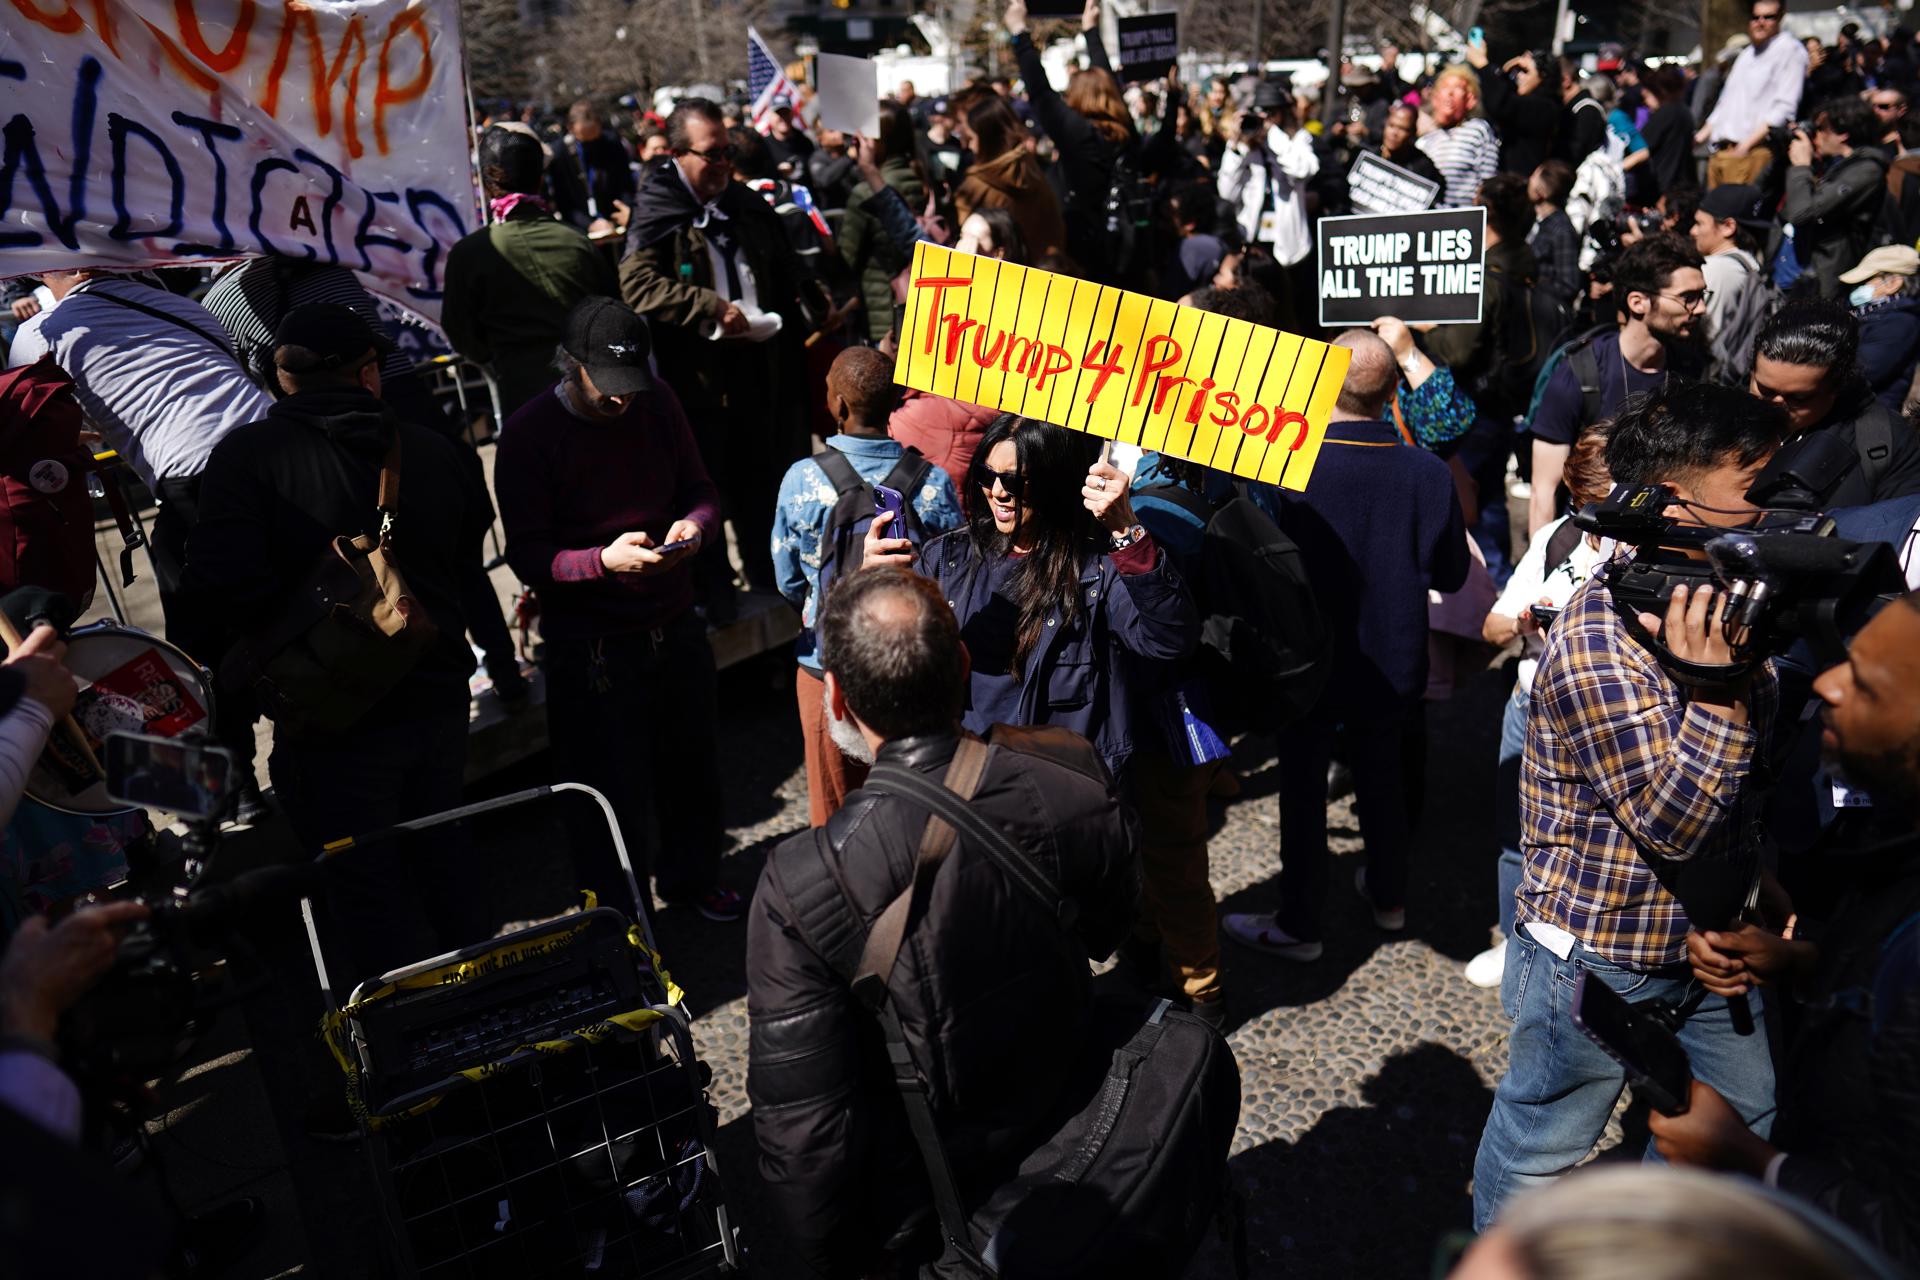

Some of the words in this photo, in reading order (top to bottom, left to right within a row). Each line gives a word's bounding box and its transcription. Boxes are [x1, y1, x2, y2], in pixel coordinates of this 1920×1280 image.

[0, 54, 467, 300] NDICTED
[1322, 268, 1361, 299] ALL
[1365, 266, 1414, 297] THE
[1420, 263, 1481, 295] TIME
[1329, 232, 1411, 266] TRUMP
[1416, 228, 1472, 262] LIES
[915, 277, 1073, 391] Trump
[1081, 340, 1125, 405] 4
[1131, 334, 1310, 451] Prison
